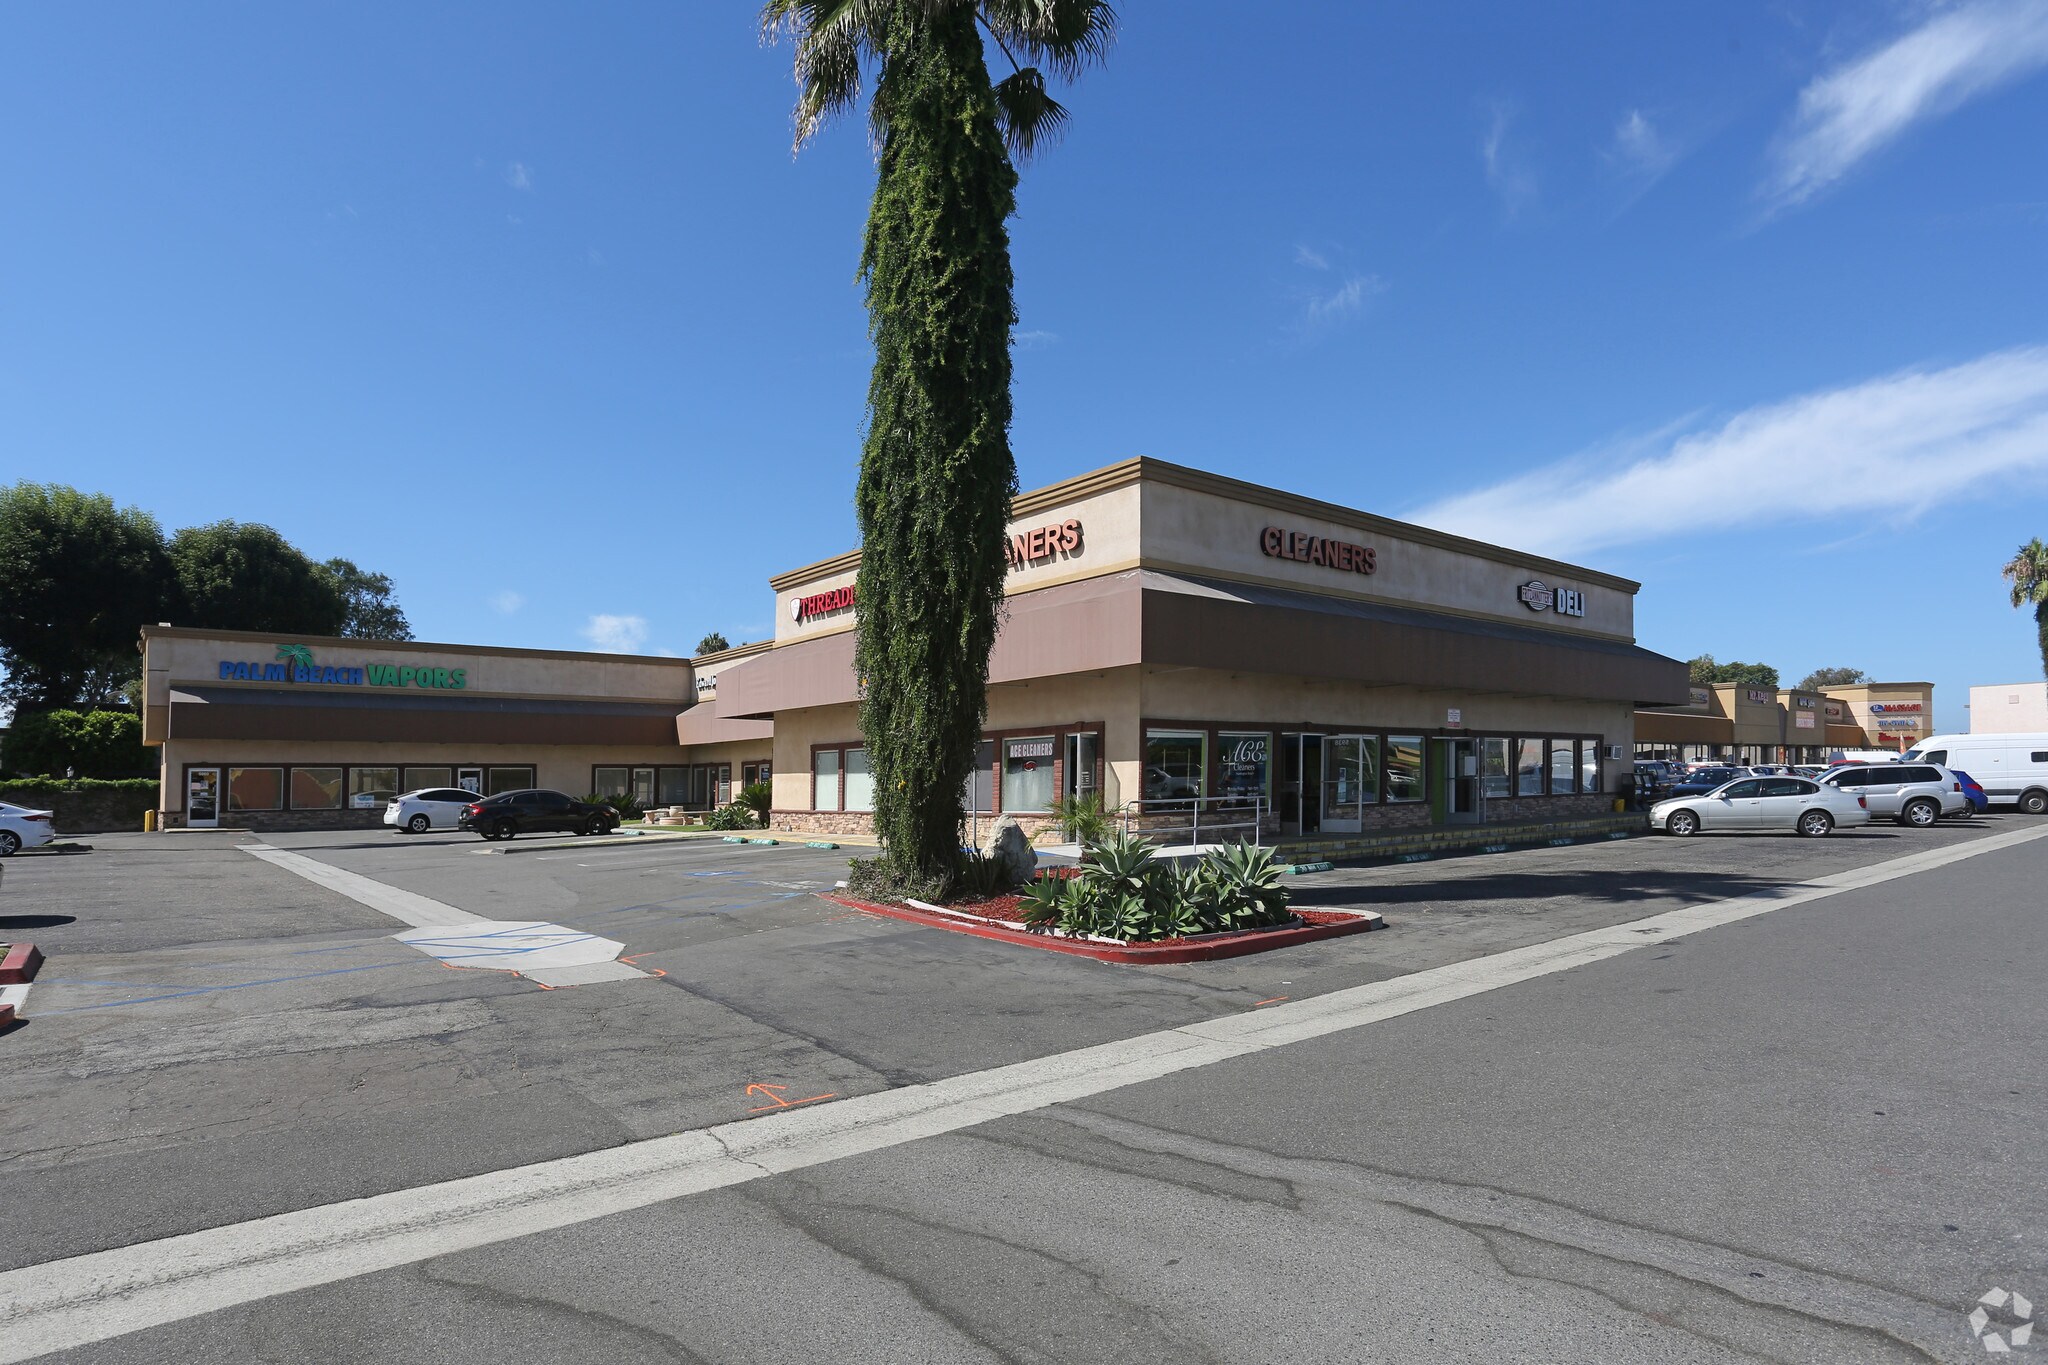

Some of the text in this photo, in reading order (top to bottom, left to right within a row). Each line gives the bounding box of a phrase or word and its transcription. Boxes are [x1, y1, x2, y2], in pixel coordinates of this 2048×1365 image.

[1261, 526, 1377, 575] CLEANERS
[1557, 587, 1585, 617] DELI
[219, 661, 467, 689] PALM BEACH VAPORS
[1884, 704, 1922, 712] MASSAGE
[1010, 743, 1053, 758] ACE CLEANERS
[1234, 763, 1255, 771] Cleaners
